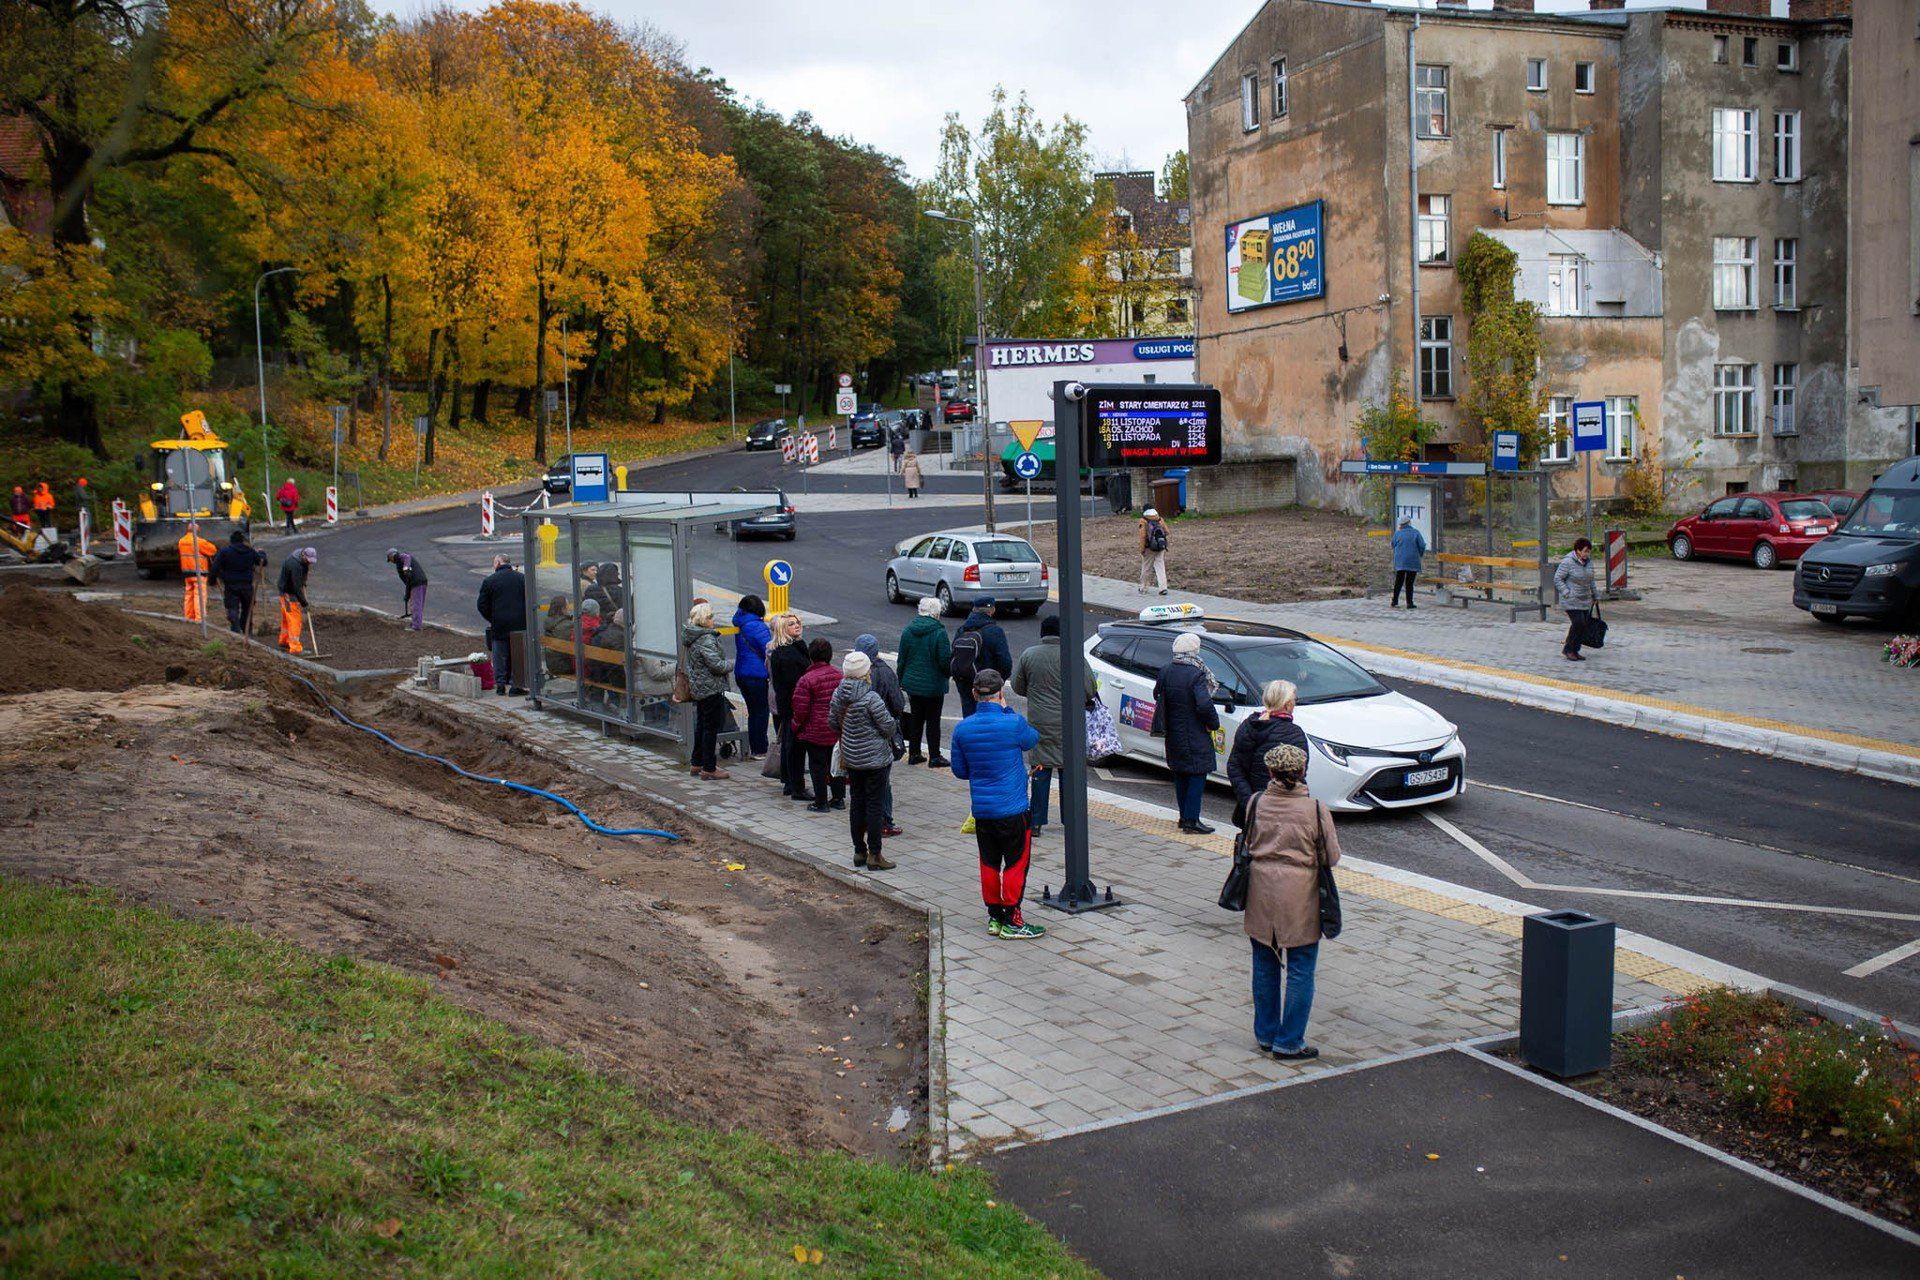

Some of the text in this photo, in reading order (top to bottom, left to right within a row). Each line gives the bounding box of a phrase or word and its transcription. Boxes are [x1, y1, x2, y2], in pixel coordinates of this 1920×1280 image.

[1272, 219, 1295, 234] WEŁNA
[1138, 345, 1171, 355] USŁUGI
[991, 343, 1095, 366] HERMES
[1120, 401, 1142, 409] STARY
[1143, 401, 1180, 409] CMENTARZ
[1181, 401, 1189, 409] 02
[1111, 418, 1119, 426] 11
[1120, 418, 1161, 426] LISTOPADA
[1188, 425, 1206, 433] 12:27
[1111, 433, 1119, 441] 11
[1120, 433, 1161, 441] LISTOPADA
